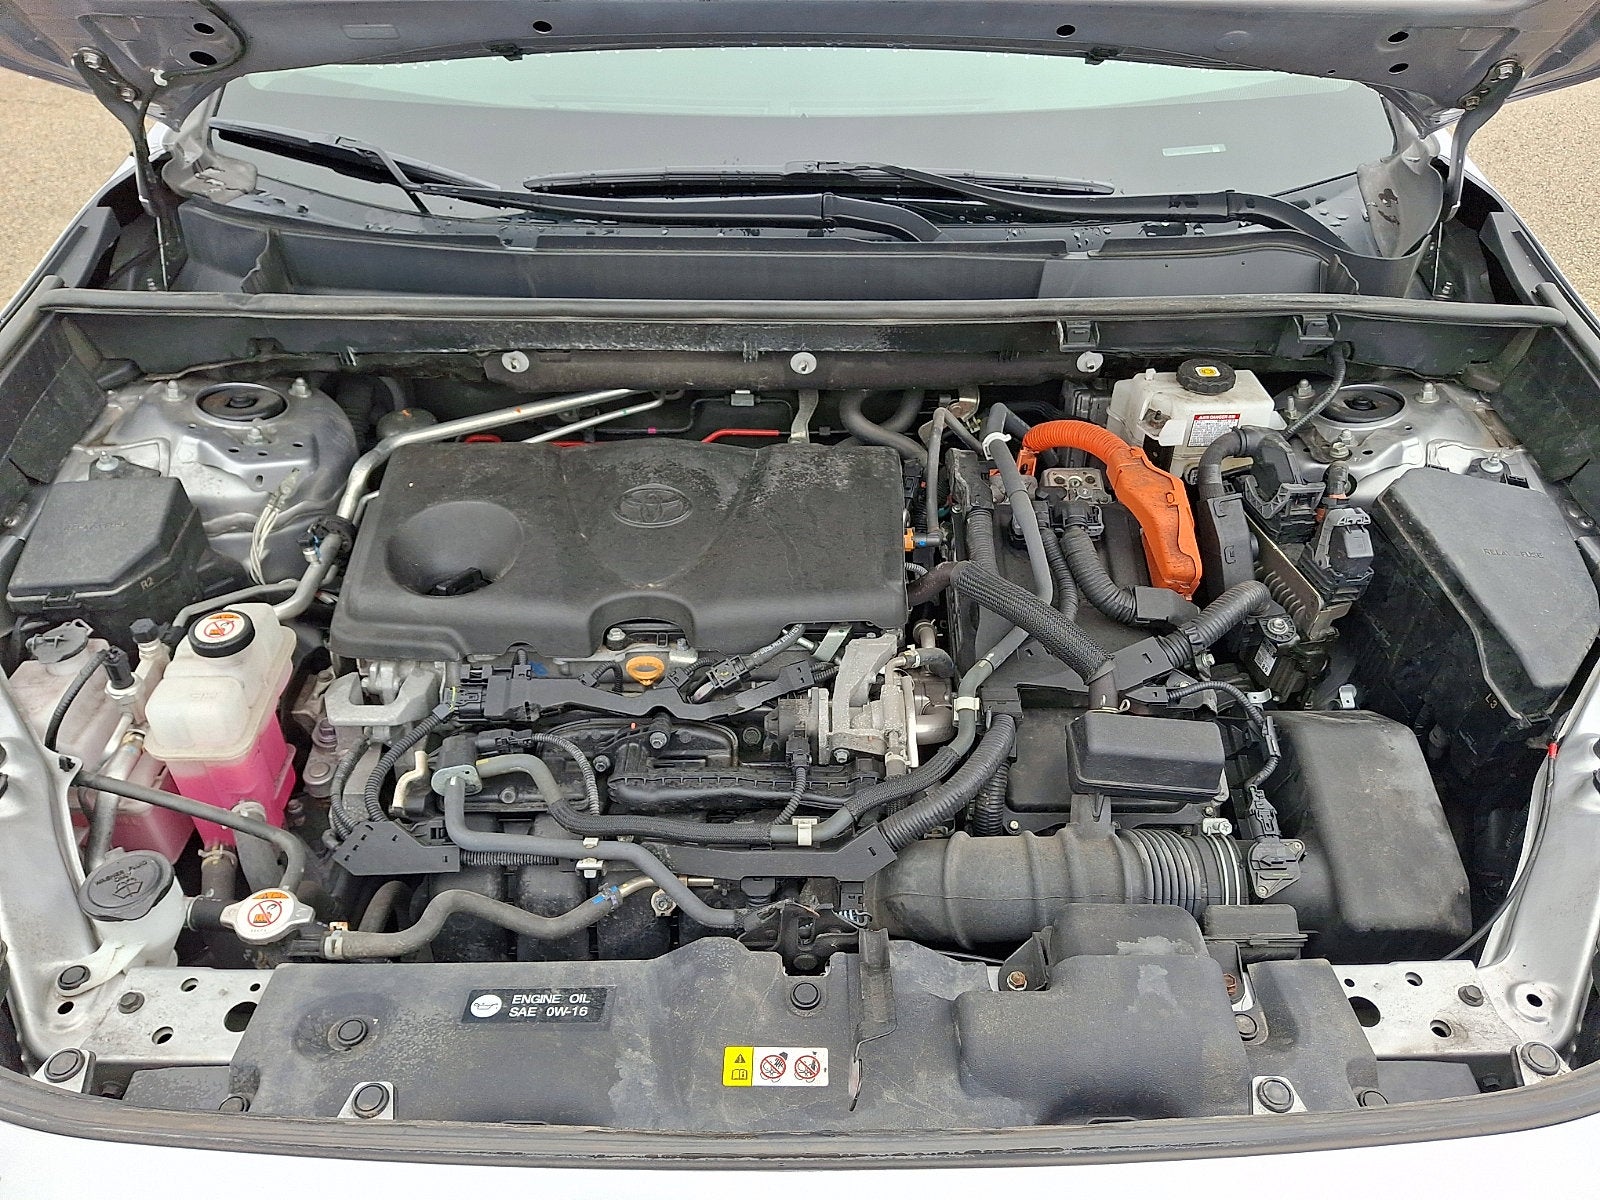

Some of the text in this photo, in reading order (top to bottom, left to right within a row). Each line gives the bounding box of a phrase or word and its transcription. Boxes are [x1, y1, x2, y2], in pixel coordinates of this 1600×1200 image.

[1485, 693, 1498, 709] L3
[511, 993, 591, 1004] ENGINE OIL
[508, 1006, 588, 1017] SAE 0W-16
